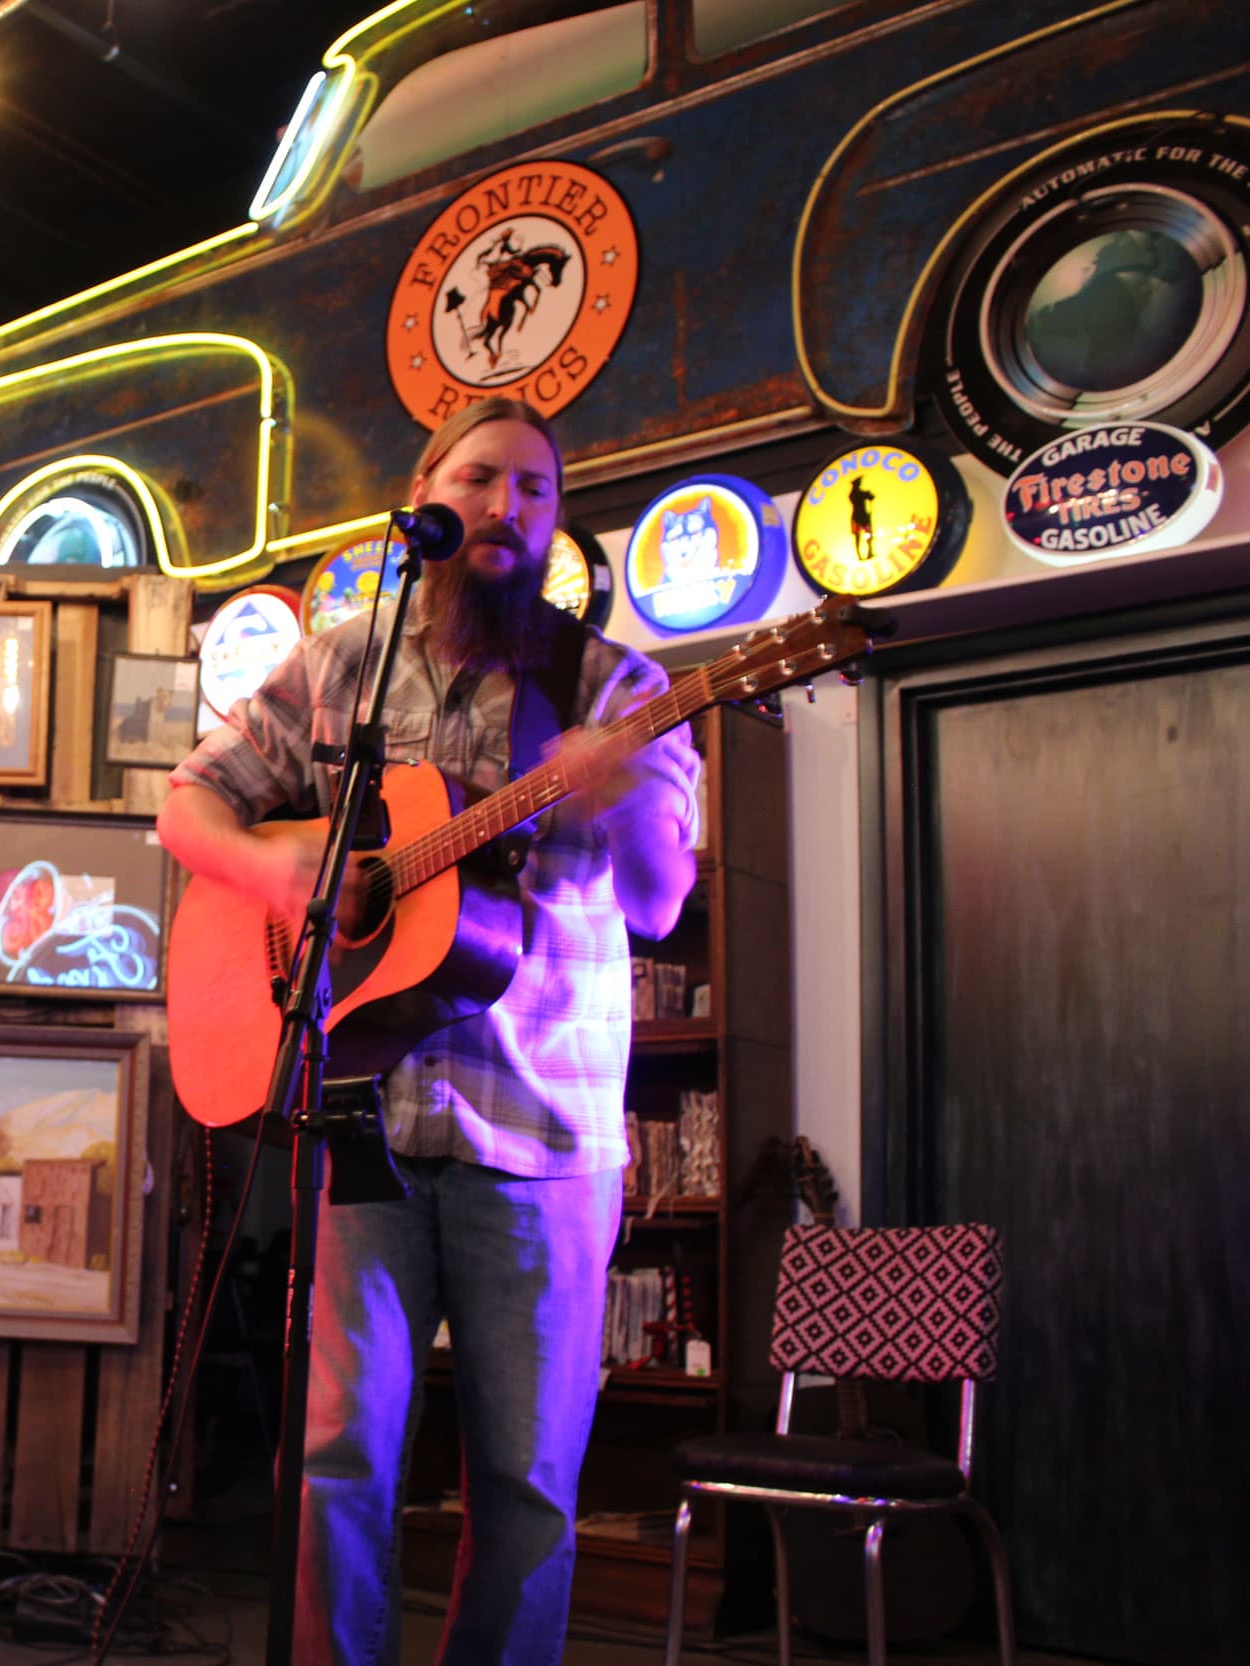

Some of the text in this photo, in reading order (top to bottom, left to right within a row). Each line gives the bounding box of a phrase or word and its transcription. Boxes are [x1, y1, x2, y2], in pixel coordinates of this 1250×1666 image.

[1022, 146, 1249, 211] AUTOMATIC FOR THE
[411, 173, 608, 292] FRONTIER
[946, 369, 1023, 462] THE PEOPLE
[1041, 427, 1146, 467] GARAGE
[808, 449, 920, 505] CONOCO
[1012, 452, 1191, 513] Firestone
[803, 514, 933, 590] GASOLINE
[1040, 503, 1168, 550] GASOLINE
